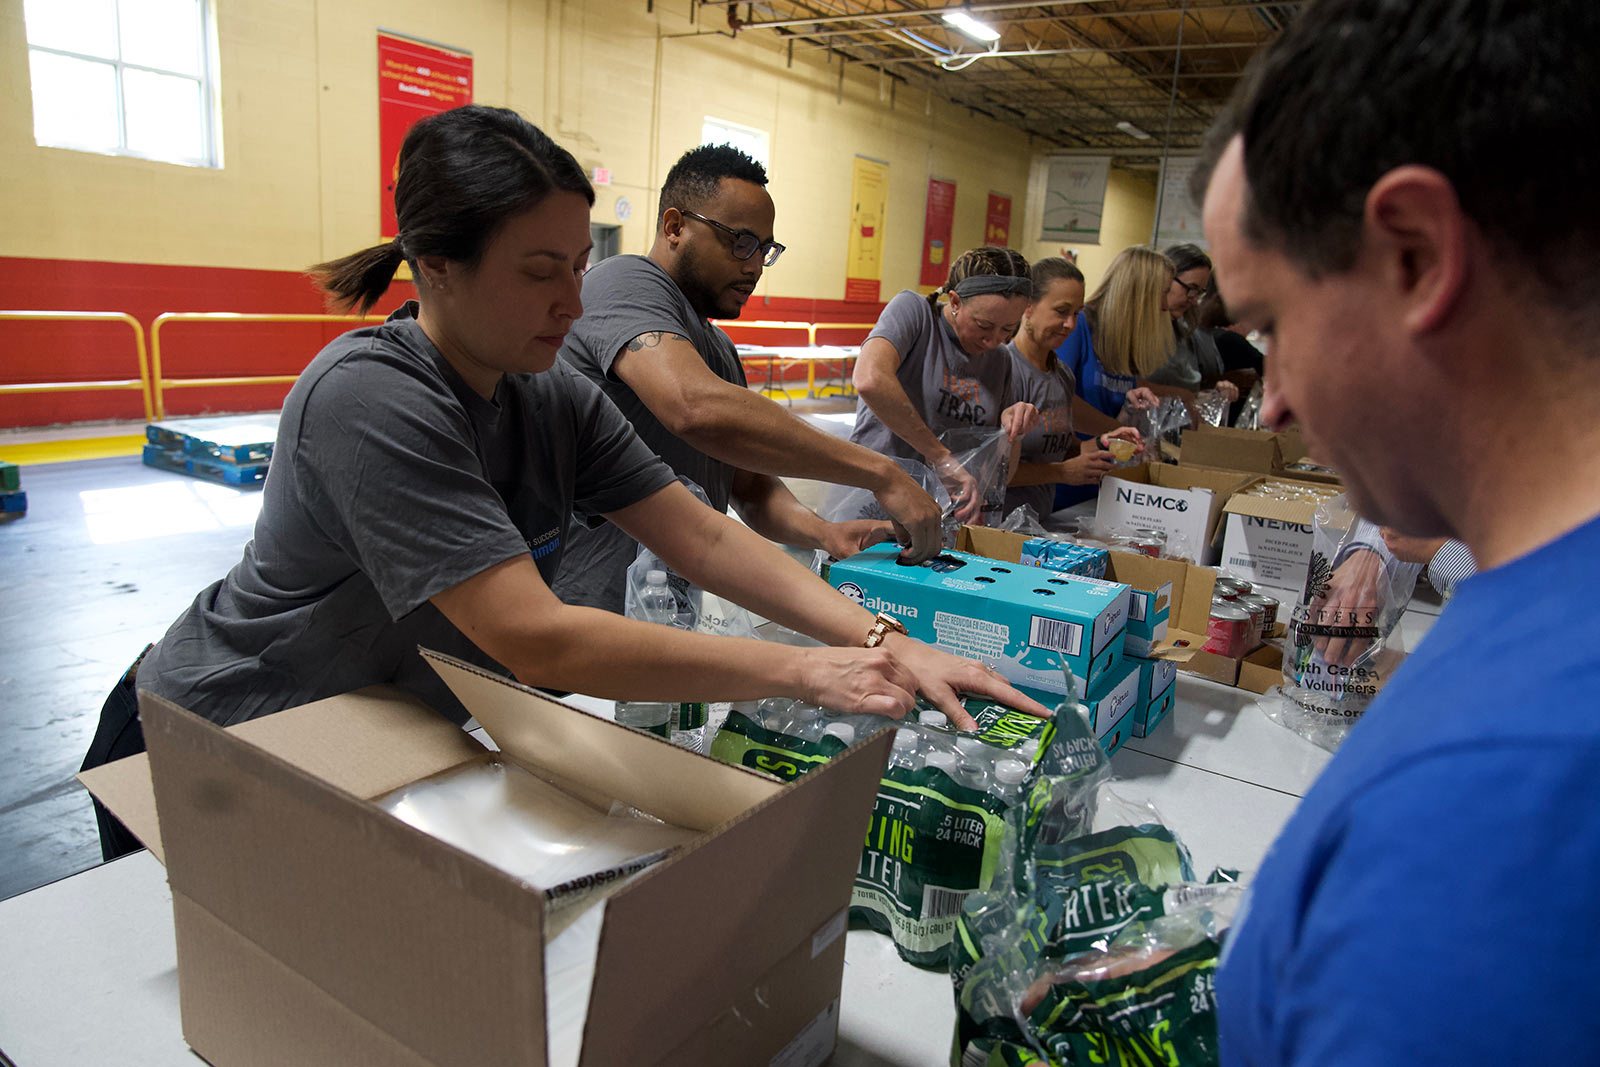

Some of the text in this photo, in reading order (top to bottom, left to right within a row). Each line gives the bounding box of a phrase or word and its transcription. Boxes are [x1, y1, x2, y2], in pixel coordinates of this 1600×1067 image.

[936, 388, 987, 426] TRAC
[865, 597, 918, 618] alpura
[936, 612, 951, 624] LECHE
[950, 614, 972, 630] REDUCIDA
[972, 619, 979, 630] EN
[979, 621, 994, 633] GRASA
[1327, 663, 1369, 679] Care
[1305, 678, 1377, 695] Volunteers
[939, 815, 985, 836] .5 LITER
[935, 827, 982, 849] 24 PACK
[857, 889, 878, 902] TOTAL
[1189, 991, 1209, 1014] 24
